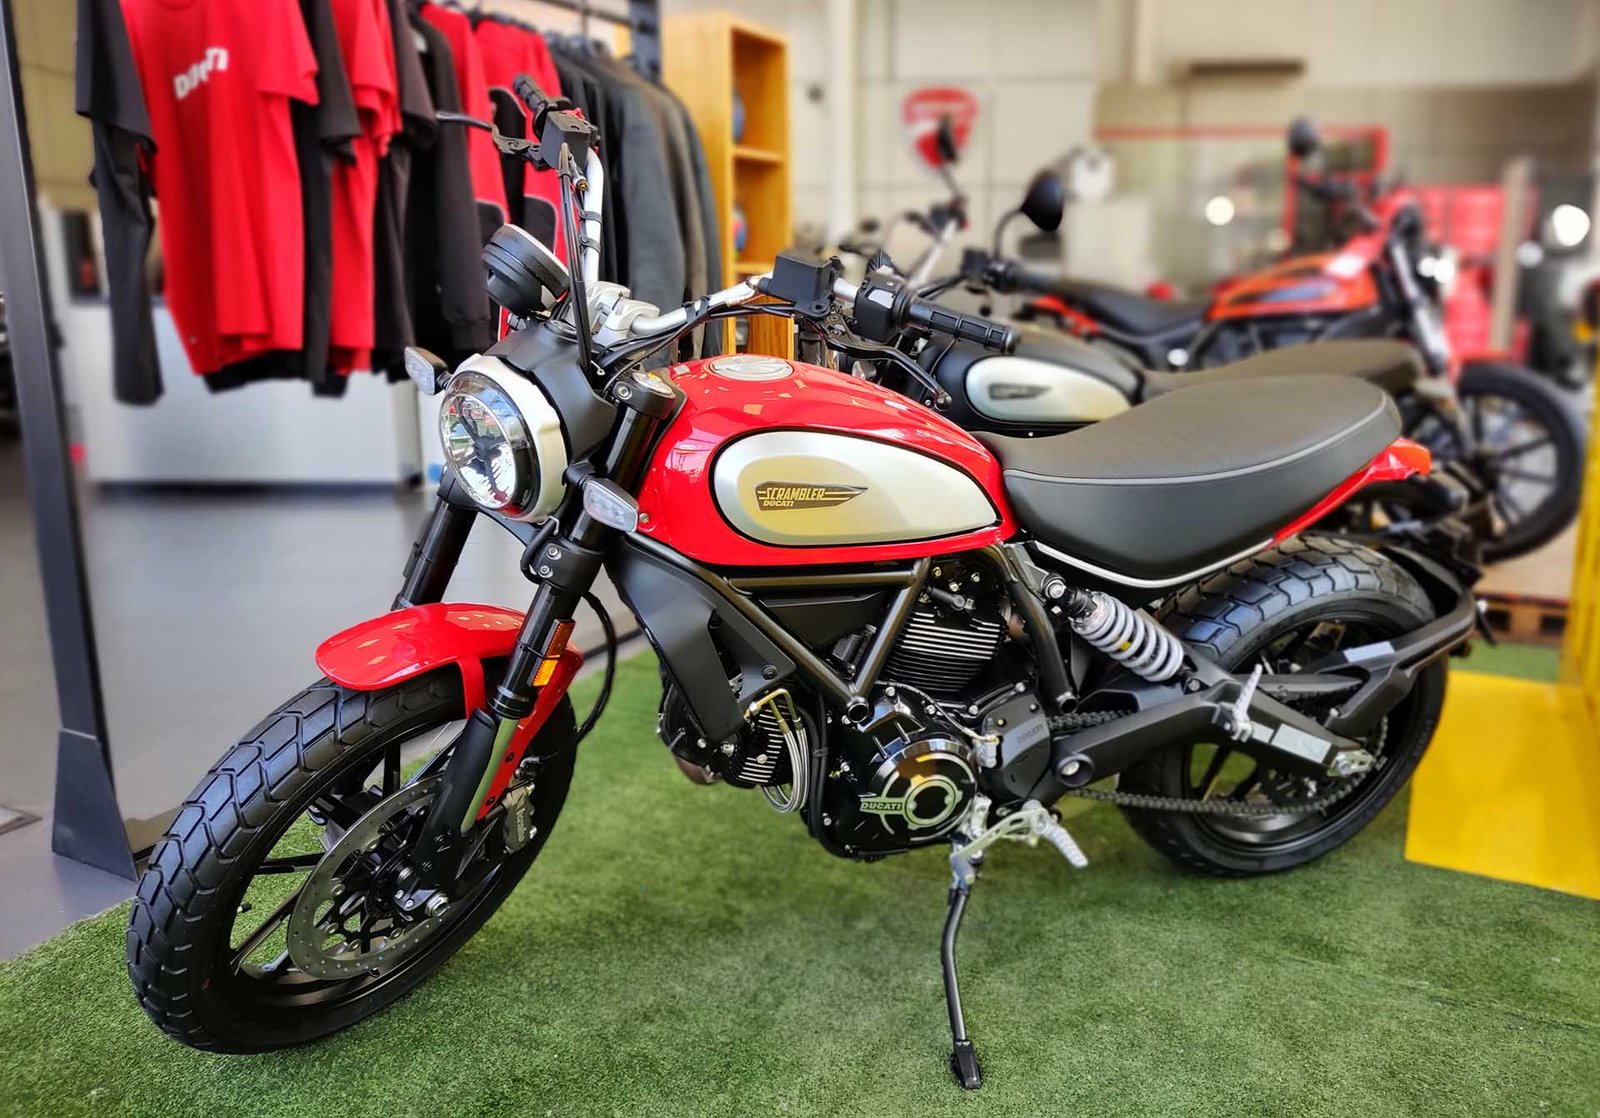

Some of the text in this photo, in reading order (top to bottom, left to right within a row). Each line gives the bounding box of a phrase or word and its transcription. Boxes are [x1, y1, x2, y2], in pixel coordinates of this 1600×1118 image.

[174, 47, 228, 99] DATI
[766, 487, 825, 501] SCRAMBLER
[860, 801, 902, 810] DUCATI
